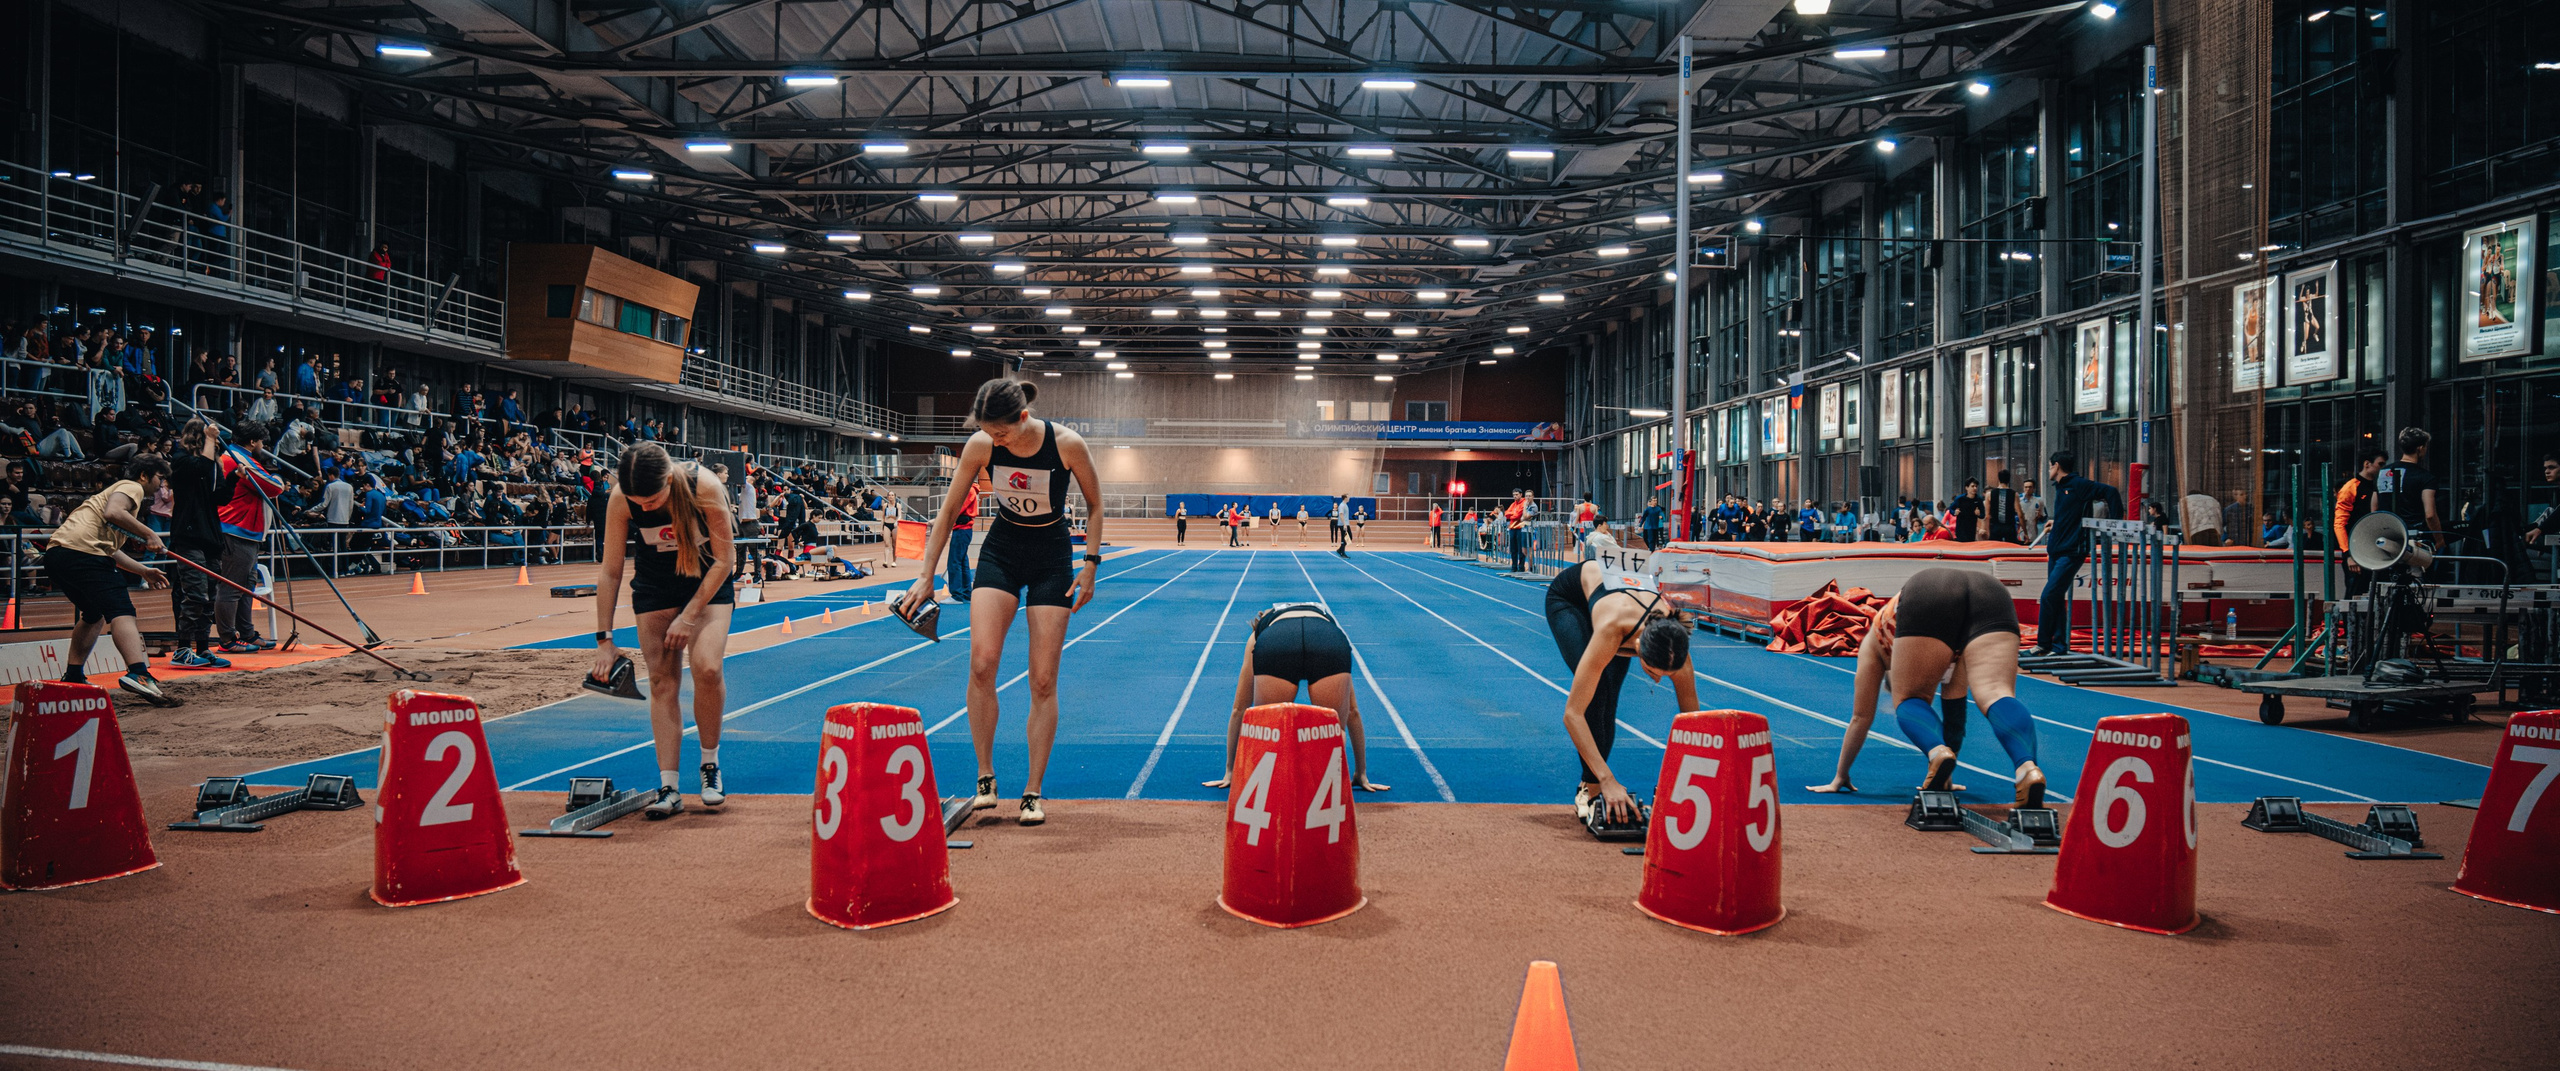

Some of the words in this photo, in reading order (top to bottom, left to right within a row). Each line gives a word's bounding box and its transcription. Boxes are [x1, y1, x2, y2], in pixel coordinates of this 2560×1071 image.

[1314, 423, 1385, 434] ОЛИМПИЙСКИЙ
[1387, 425, 1417, 434] ЦЕНТР
[1418, 426, 1443, 434] имени
[1445, 426, 1476, 435] братьев
[1478, 426, 1526, 434] Знаменских
[1007, 496, 1038, 513] 80
[1601, 550, 1646, 573] 414
[40, 645, 57, 663] 14
[38, 697, 107, 715] MONDO
[410, 708, 476, 726] MONDO
[871, 721, 923, 740] MONDO
[1241, 723, 1280, 742] MONDO
[1297, 723, 1341, 742] MONDO
[1672, 728, 1724, 749] MONDO
[2096, 728, 2161, 749] MONDO
[54, 717, 100, 810] 1
[420, 730, 477, 827] 2
[2507, 744, 2560, 833] 7
[815, 745, 848, 840] 3
[880, 744, 926, 842] 3
[1233, 751, 1278, 847] 4
[1305, 746, 1346, 845] 4
[1665, 754, 1720, 851] 5
[1745, 753, 1776, 853] 5
[2092, 756, 2154, 848] 6
